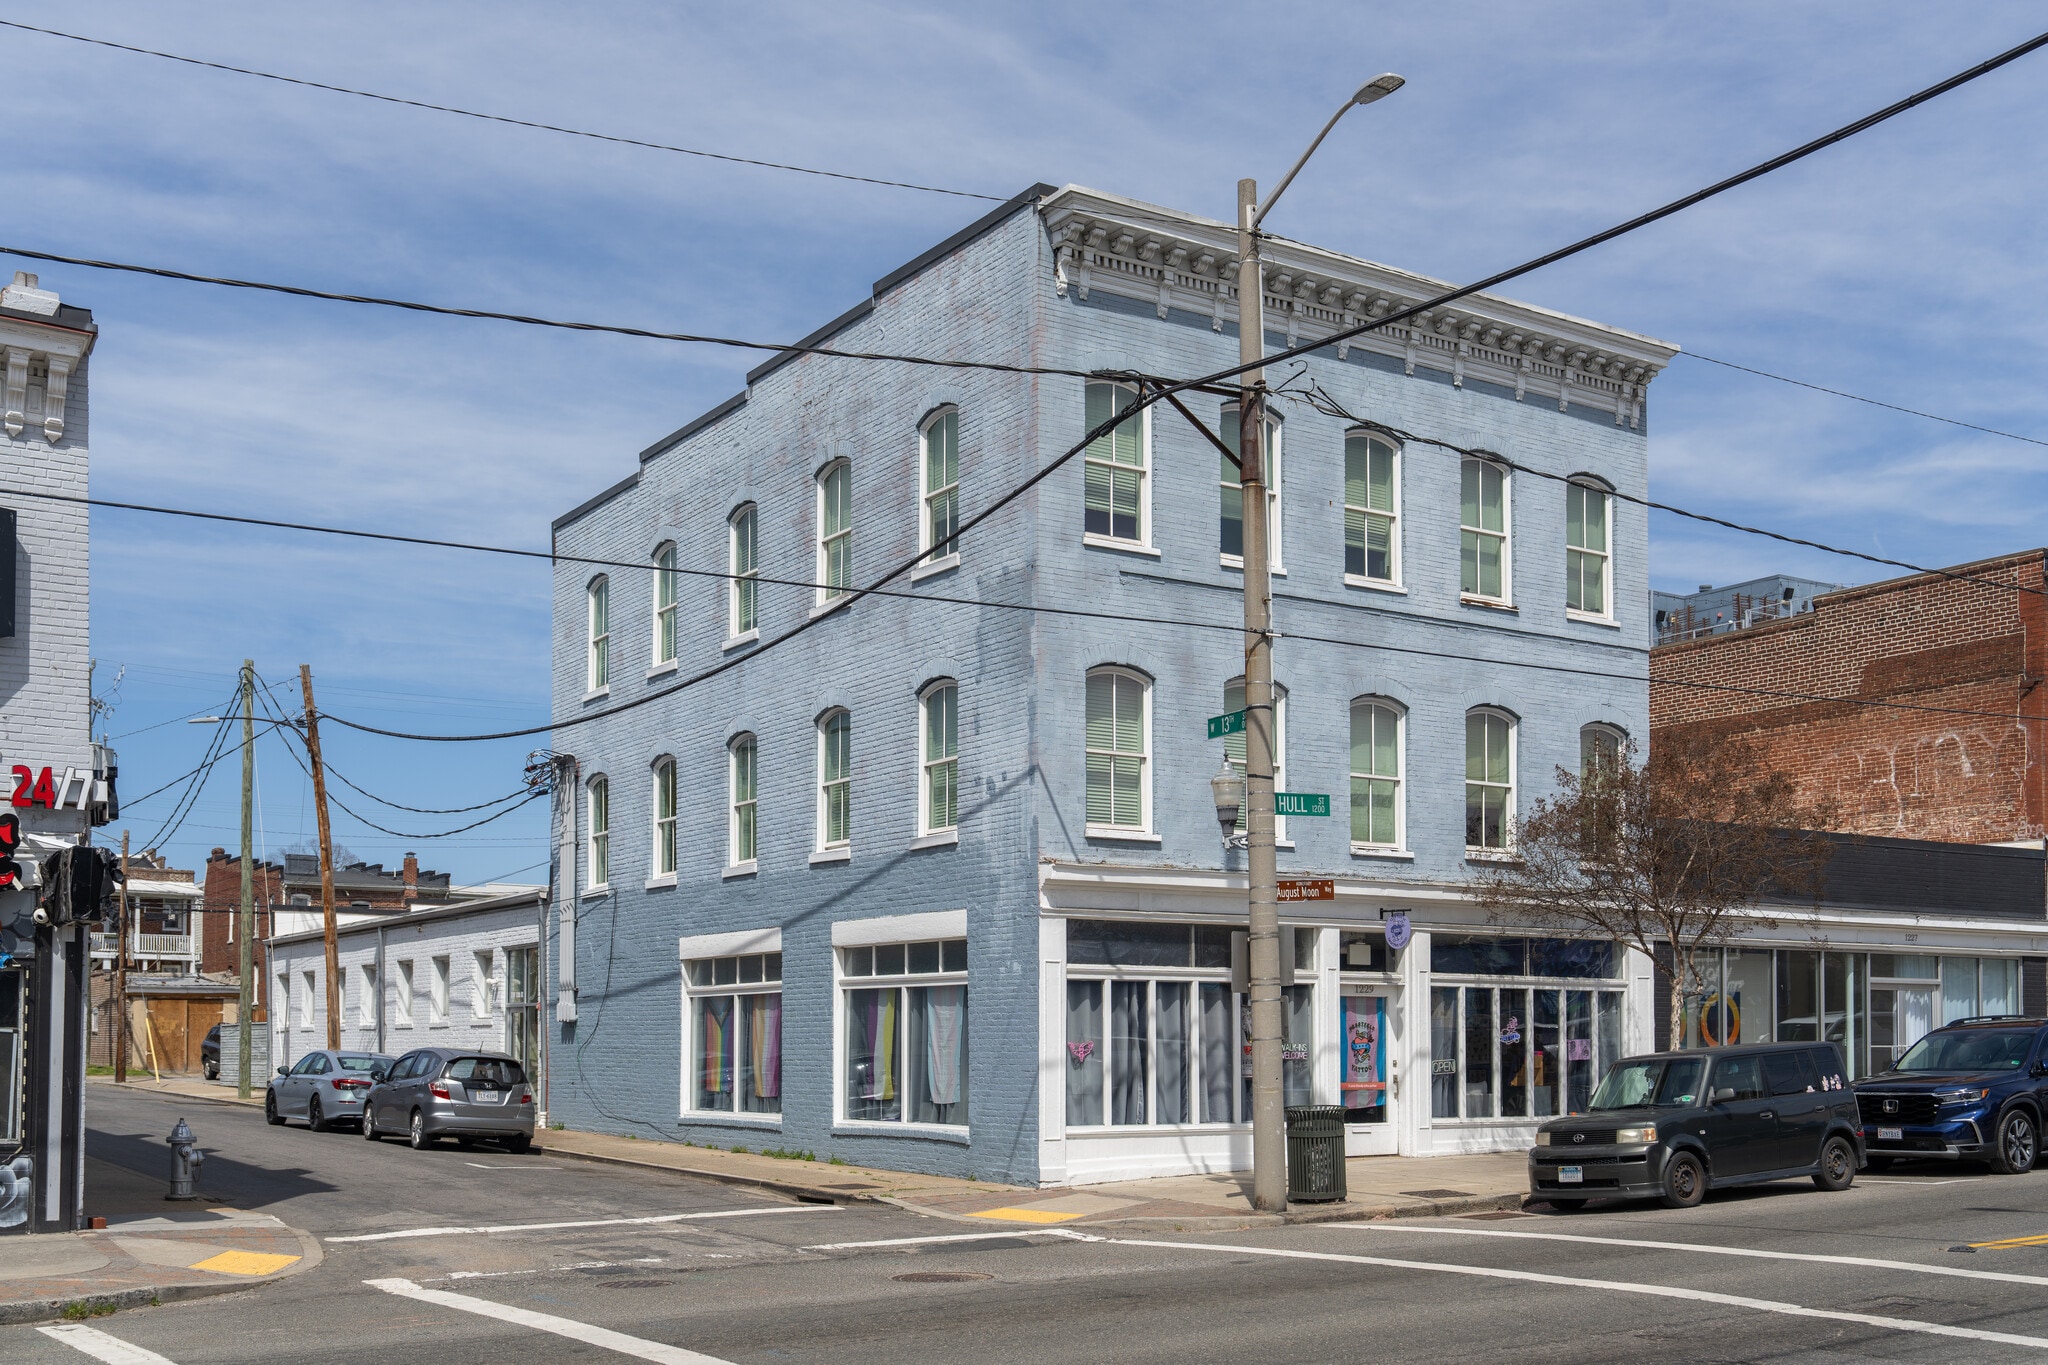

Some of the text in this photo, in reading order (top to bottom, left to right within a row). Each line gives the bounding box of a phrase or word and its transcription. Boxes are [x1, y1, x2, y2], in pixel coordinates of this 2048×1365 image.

[1210, 723, 1215, 733] W
[1221, 715, 1235, 733] 13TH
[12, 764, 94, 811] 24/7
[1278, 795, 1325, 813] HULL ST
[1312, 804, 1326, 814] 1200
[1277, 887, 1300, 900] August
[1301, 886, 1320, 898] Moon
[1904, 933, 1918, 941] 1227
[1355, 984, 1375, 994] 1229
[1351, 1064, 1373, 1073] TATTOO
[1433, 1061, 1455, 1073] OPEN
